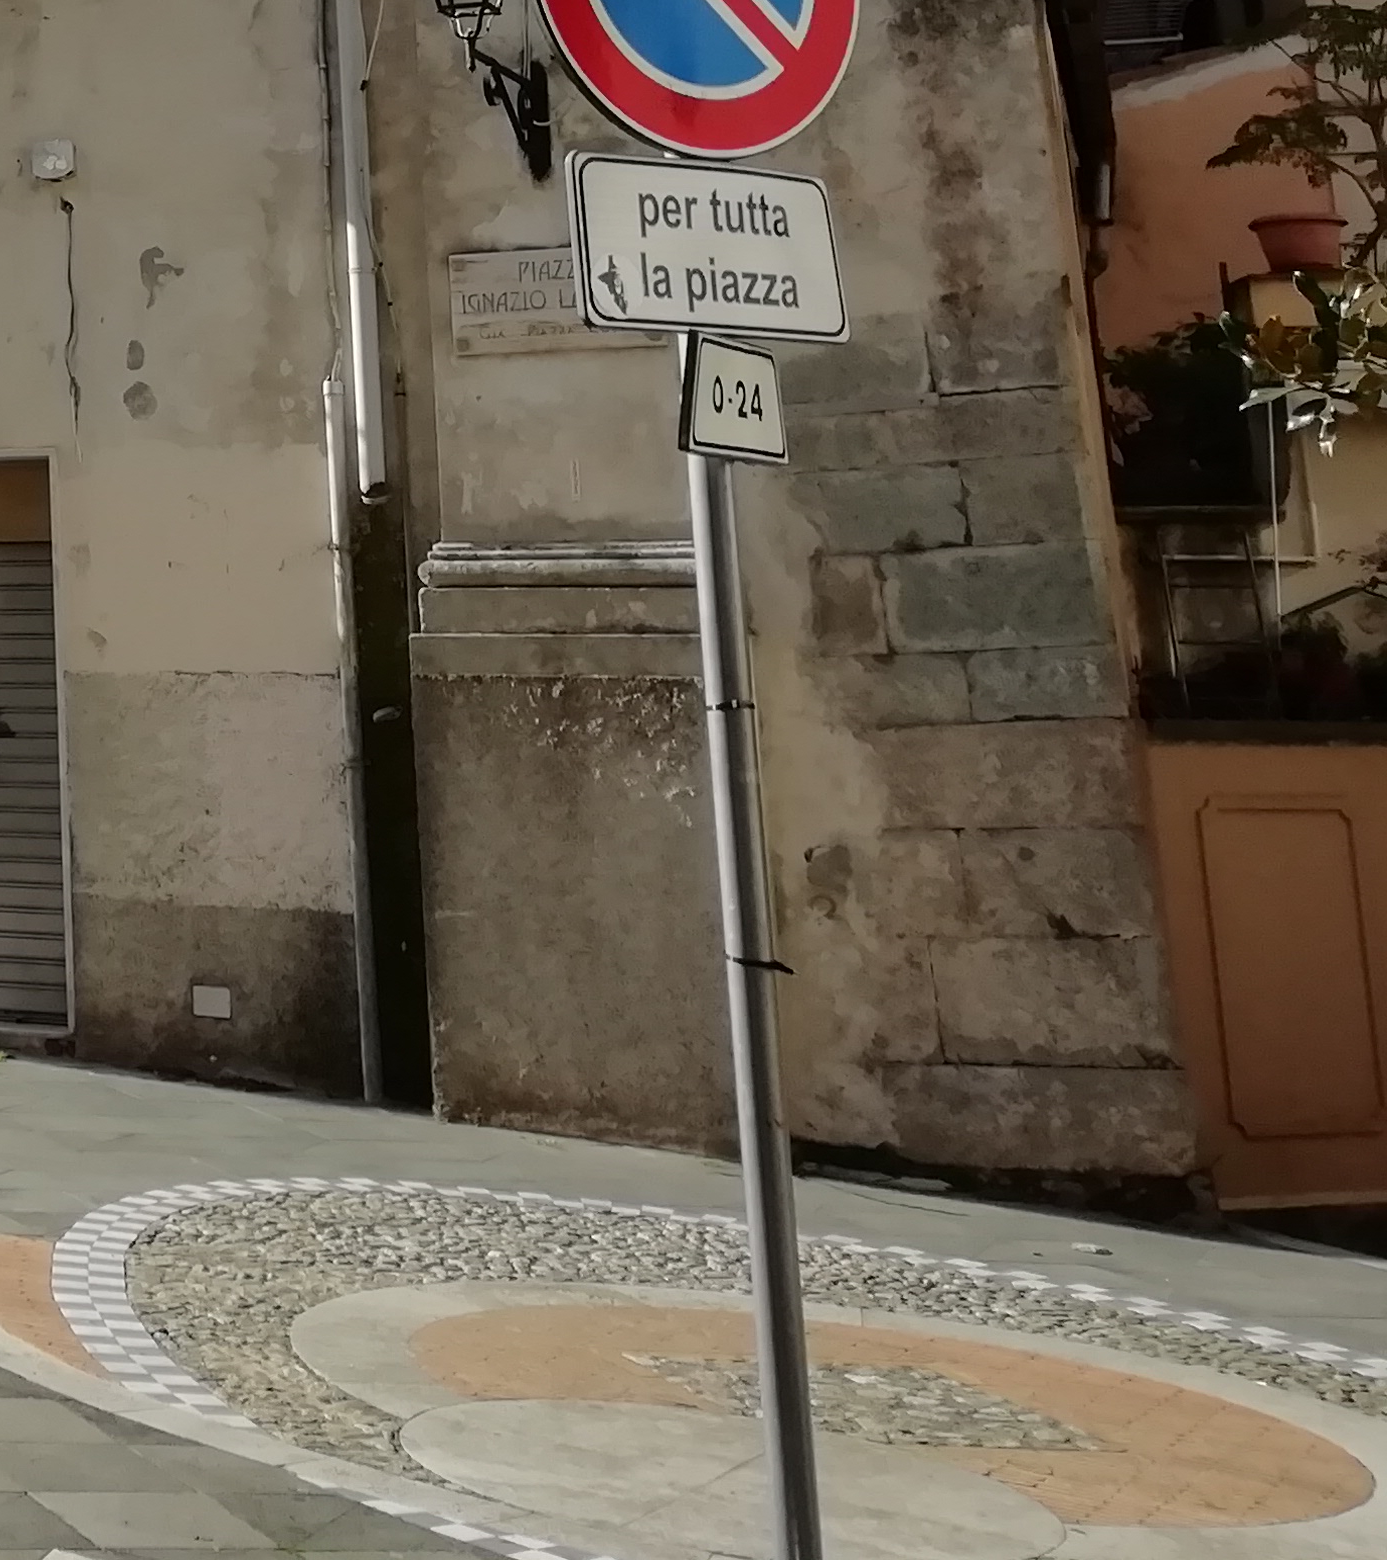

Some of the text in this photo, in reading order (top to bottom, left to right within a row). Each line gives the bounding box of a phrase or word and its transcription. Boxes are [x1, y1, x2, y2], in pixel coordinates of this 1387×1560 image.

[638, 188, 791, 238] per tutta
[517, 258, 575, 283] PIAZZ
[639, 252, 801, 313] la piazza
[461, 288, 547, 315] IGNAZIO
